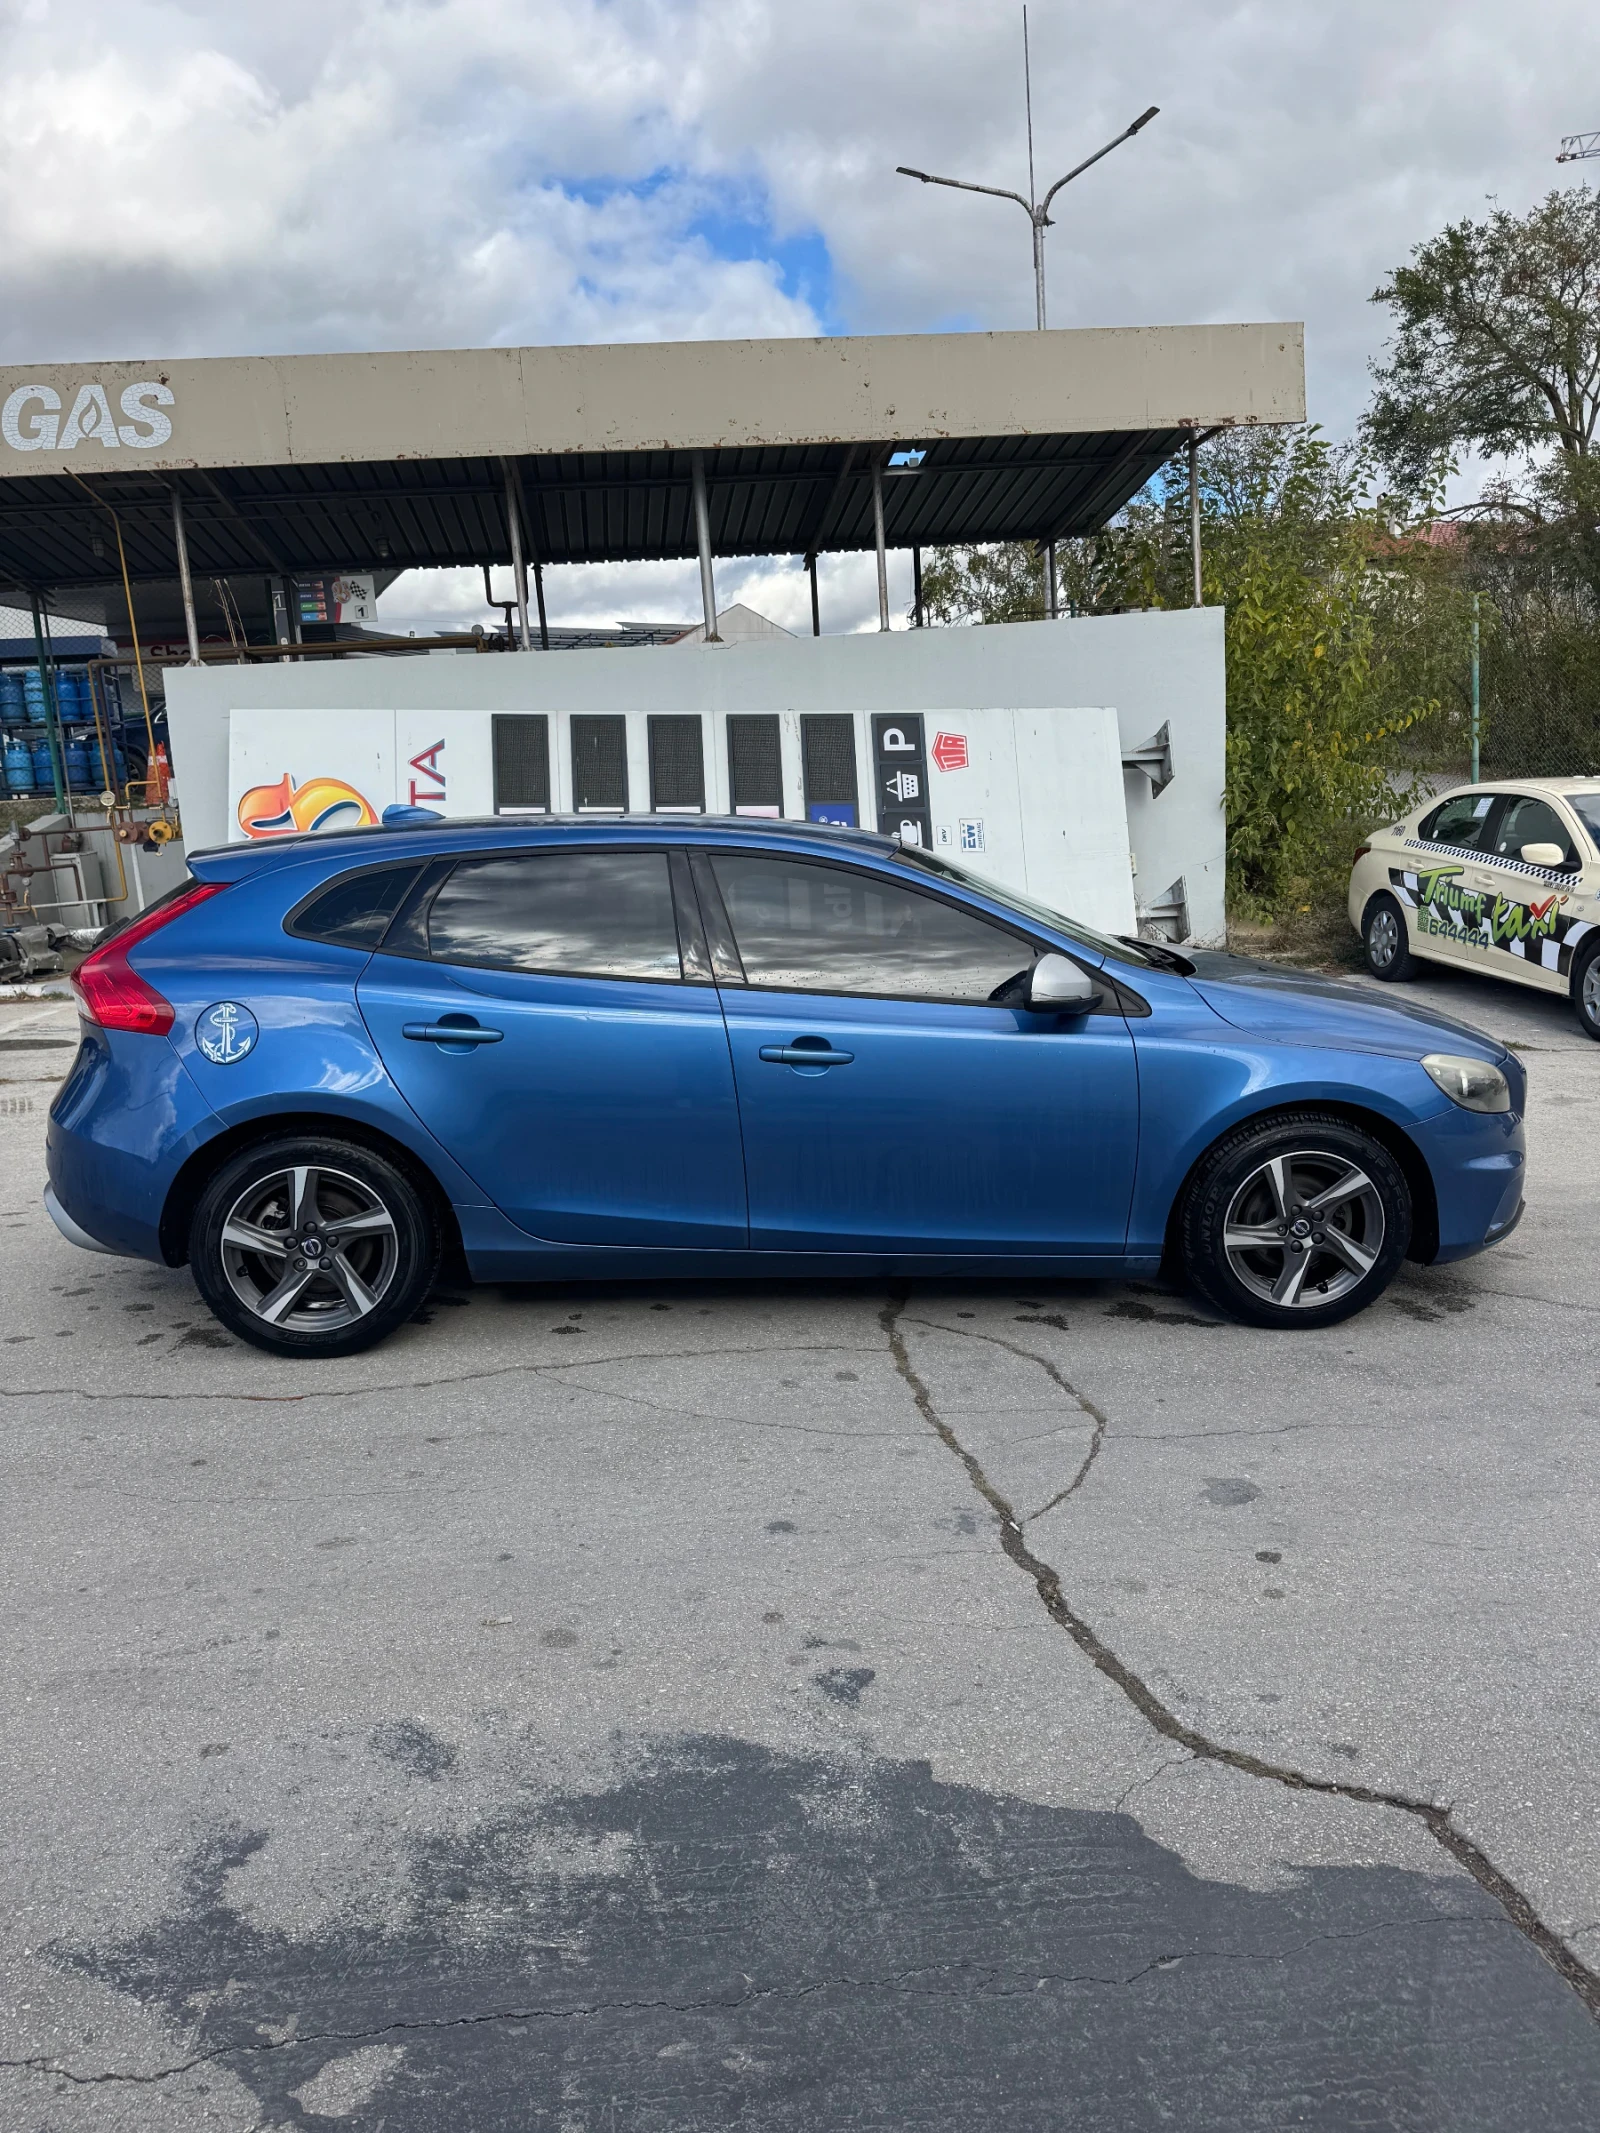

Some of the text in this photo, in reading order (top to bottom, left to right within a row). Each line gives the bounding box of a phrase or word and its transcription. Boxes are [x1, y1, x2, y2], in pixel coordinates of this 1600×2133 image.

[1, 381, 175, 451] GAS
[357, 606, 364, 617] 1
[884, 728, 915, 751] P
[932, 732, 969, 772] UTA
[1418, 866, 1569, 942] Triumf taxi
[1429, 918, 1489, 949] 644444
